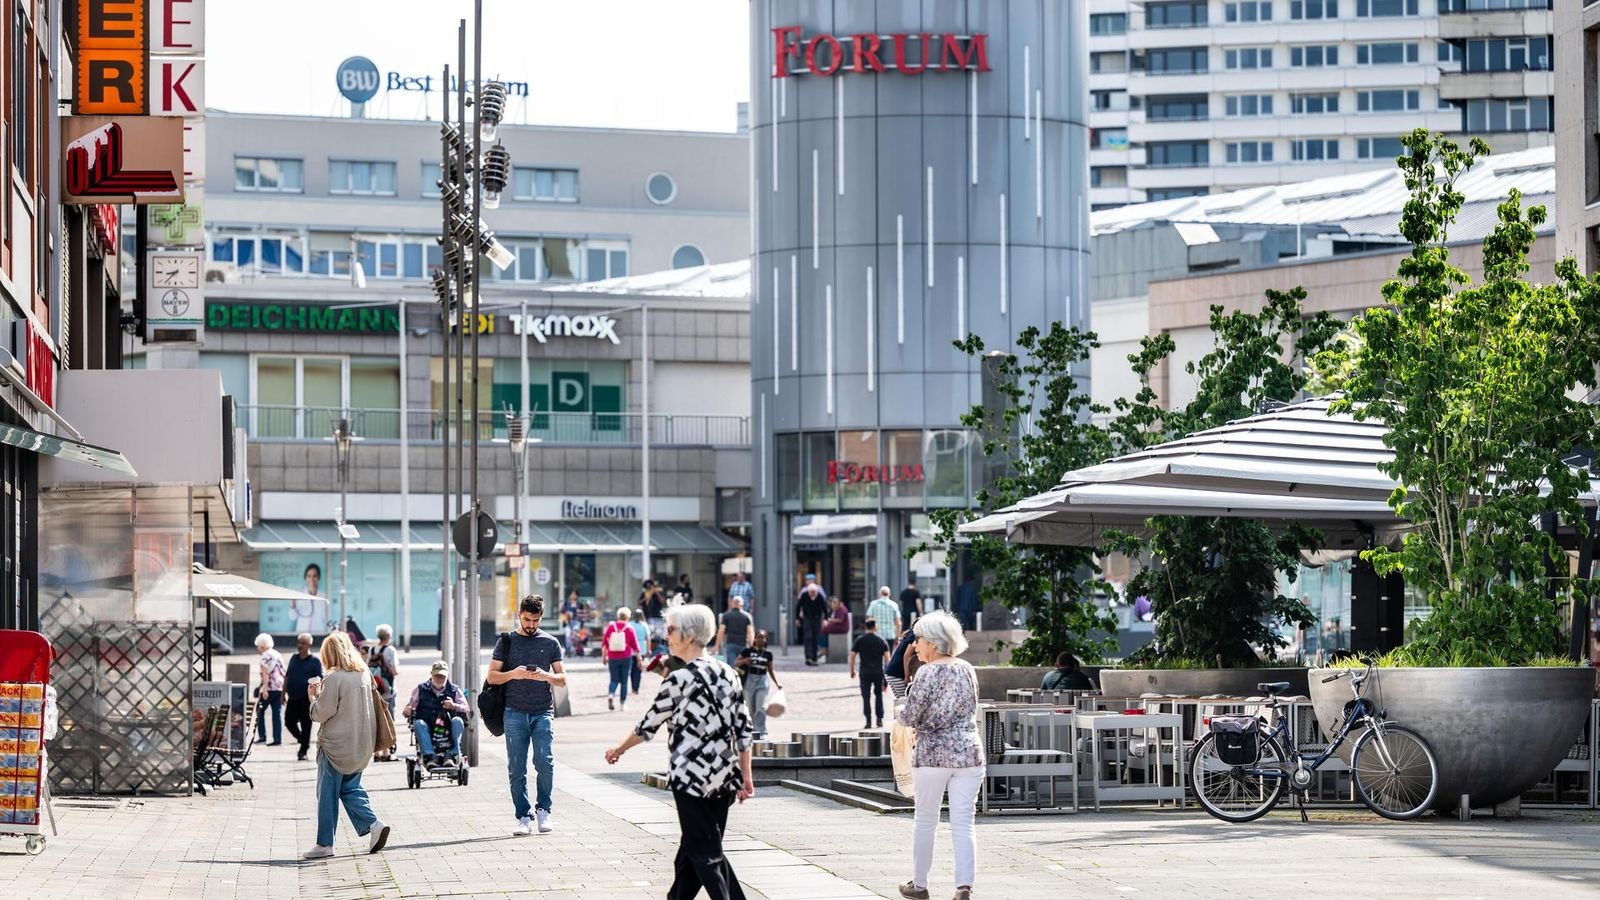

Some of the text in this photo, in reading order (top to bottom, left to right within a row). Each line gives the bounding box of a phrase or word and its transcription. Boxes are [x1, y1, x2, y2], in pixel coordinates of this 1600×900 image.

[770, 26, 993, 79] FORUM
[342, 69, 378, 92] BW
[387, 71, 432, 93] Best
[206, 303, 400, 333] DEICHMANN
[559, 379, 585, 406] D
[826, 460, 925, 484] FORUM
